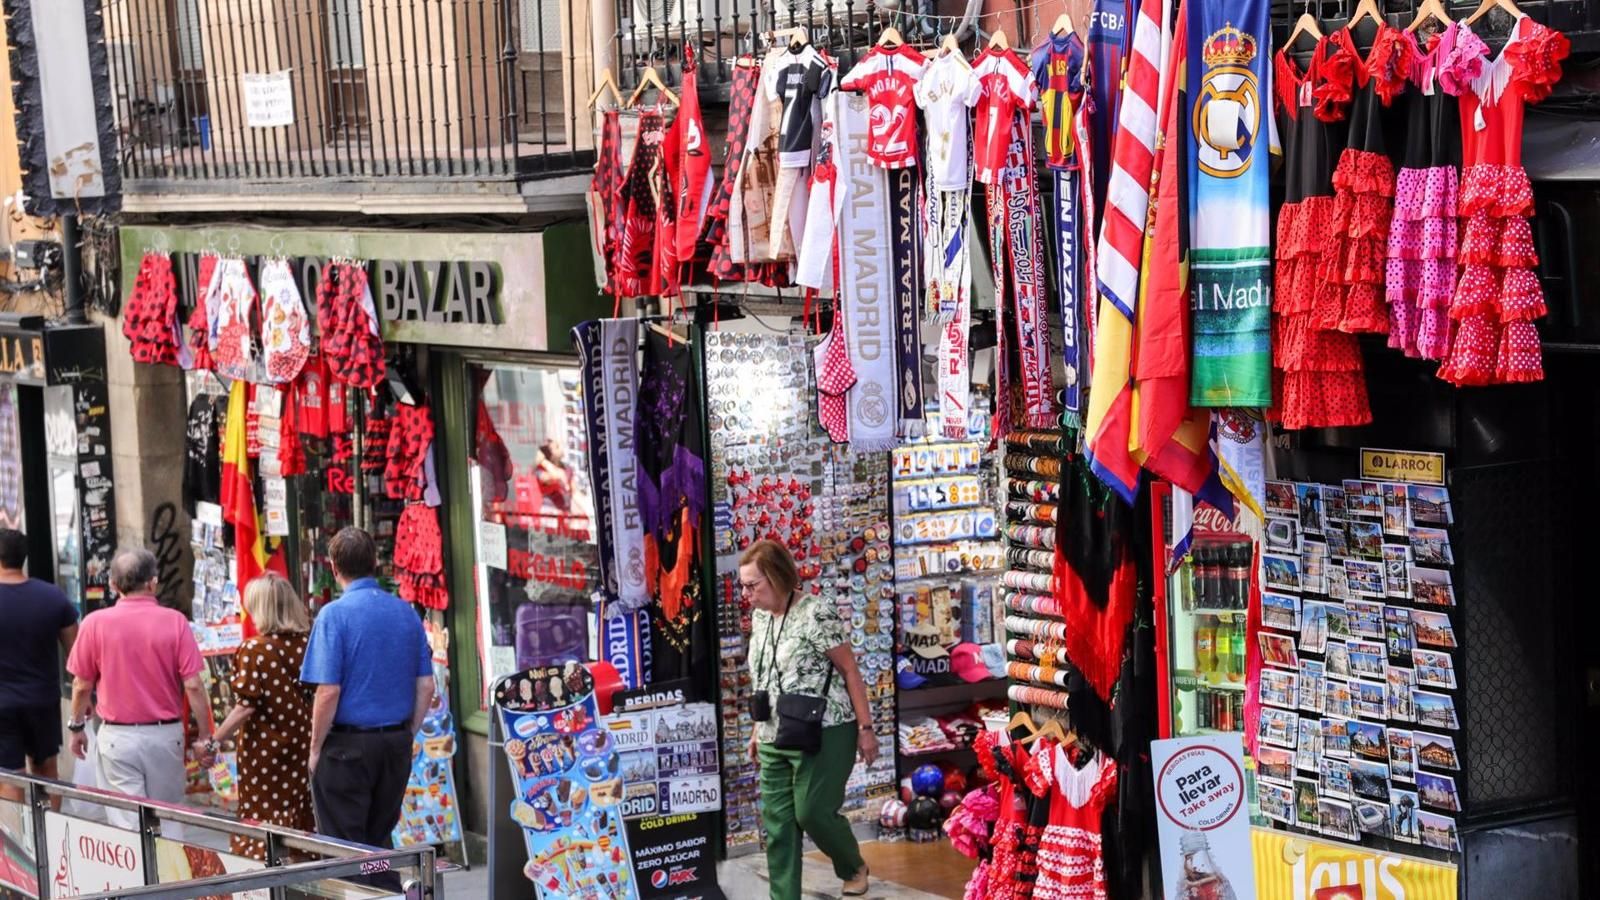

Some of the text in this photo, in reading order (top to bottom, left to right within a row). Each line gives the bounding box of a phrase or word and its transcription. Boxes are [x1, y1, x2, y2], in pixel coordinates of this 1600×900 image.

[848, 133, 882, 361] REAL MADRID
[899, 169, 913, 331] REAL MAD
[379, 258, 504, 325] BAZAR
[1061, 232, 1074, 347] HAZARD
[1213, 278, 1271, 311] Madr
[612, 337, 641, 530] REAL MADRID
[608, 614, 631, 690] ADRID
[904, 631, 940, 648] MAD
[615, 731, 649, 745] ADRID
[1176, 765, 1212, 791] Para
[1178, 774, 1221, 805] llevar
[621, 797, 656, 816] DRID
[661, 800, 669, 811] E
[1178, 782, 1235, 818] Take away
[640, 813, 698, 830] COLD DRINKS
[1198, 803, 1234, 826] COLD DRINKS
[675, 836, 707, 850] SABOR
[637, 858, 662, 870] ZERO
